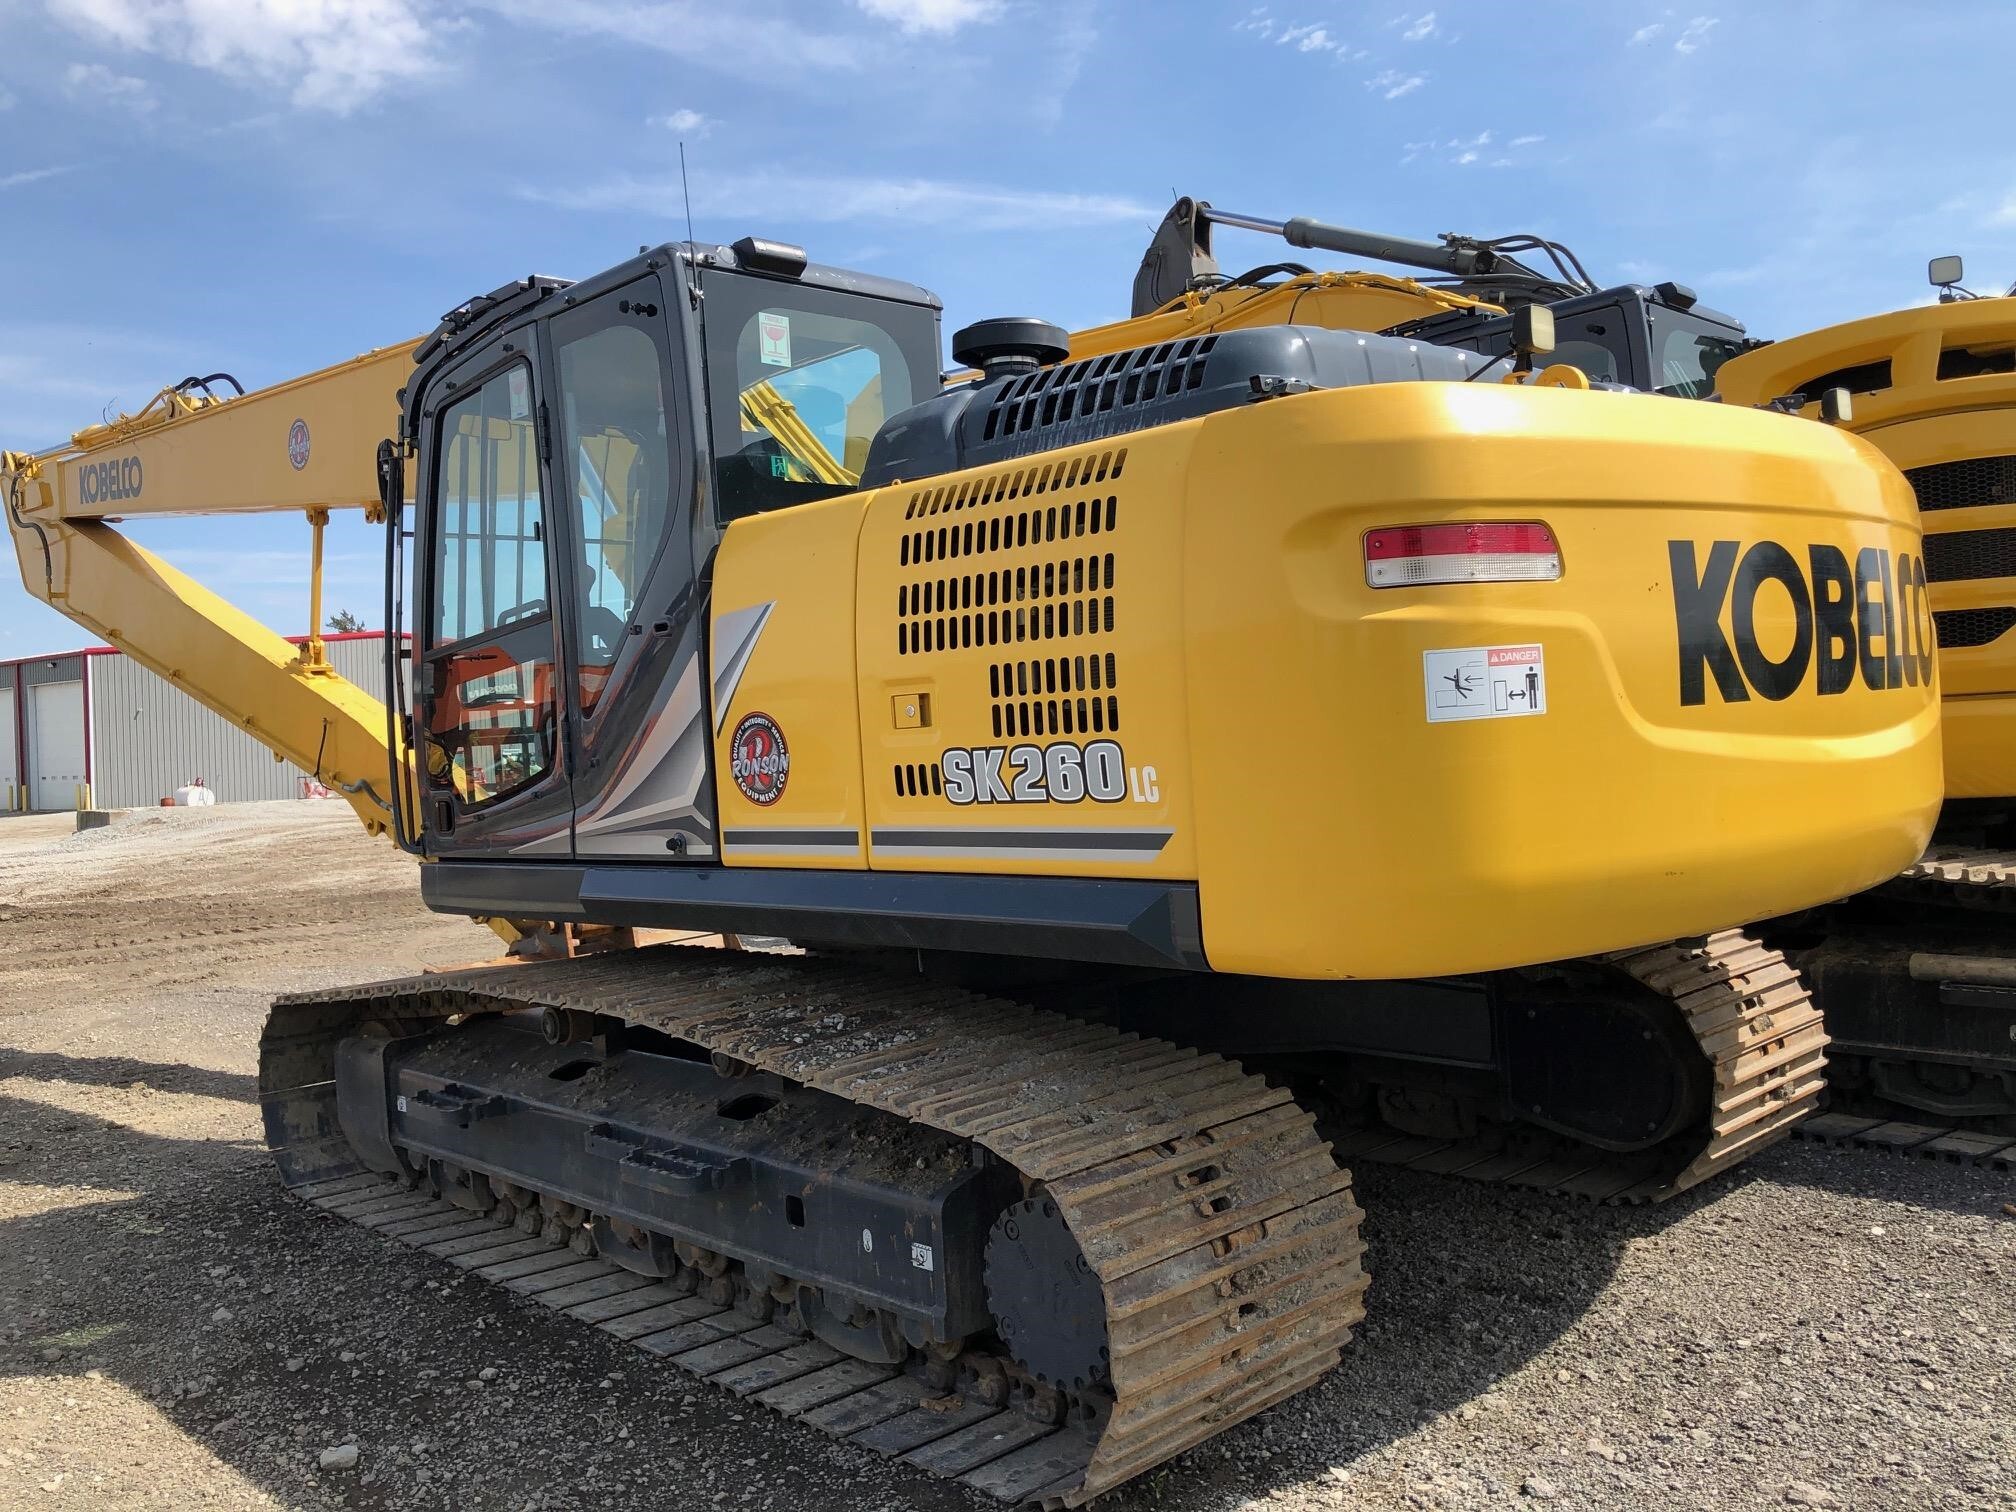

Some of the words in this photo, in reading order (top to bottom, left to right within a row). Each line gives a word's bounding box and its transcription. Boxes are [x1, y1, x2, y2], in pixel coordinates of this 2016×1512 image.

[79, 456, 143, 505] KOBELCO
[1667, 540, 1933, 707] KOBELCO
[1500, 650, 1539, 663] DANGER
[733, 730, 743, 759] QUALITY
[744, 717, 770, 729] INTEGRITY
[770, 727, 786, 754] SERVICE
[732, 753, 790, 779] RONSON
[941, 739, 1128, 806] SK260
[1129, 766, 1160, 803] LC
[738, 777, 779, 803] EQUIPMENT
